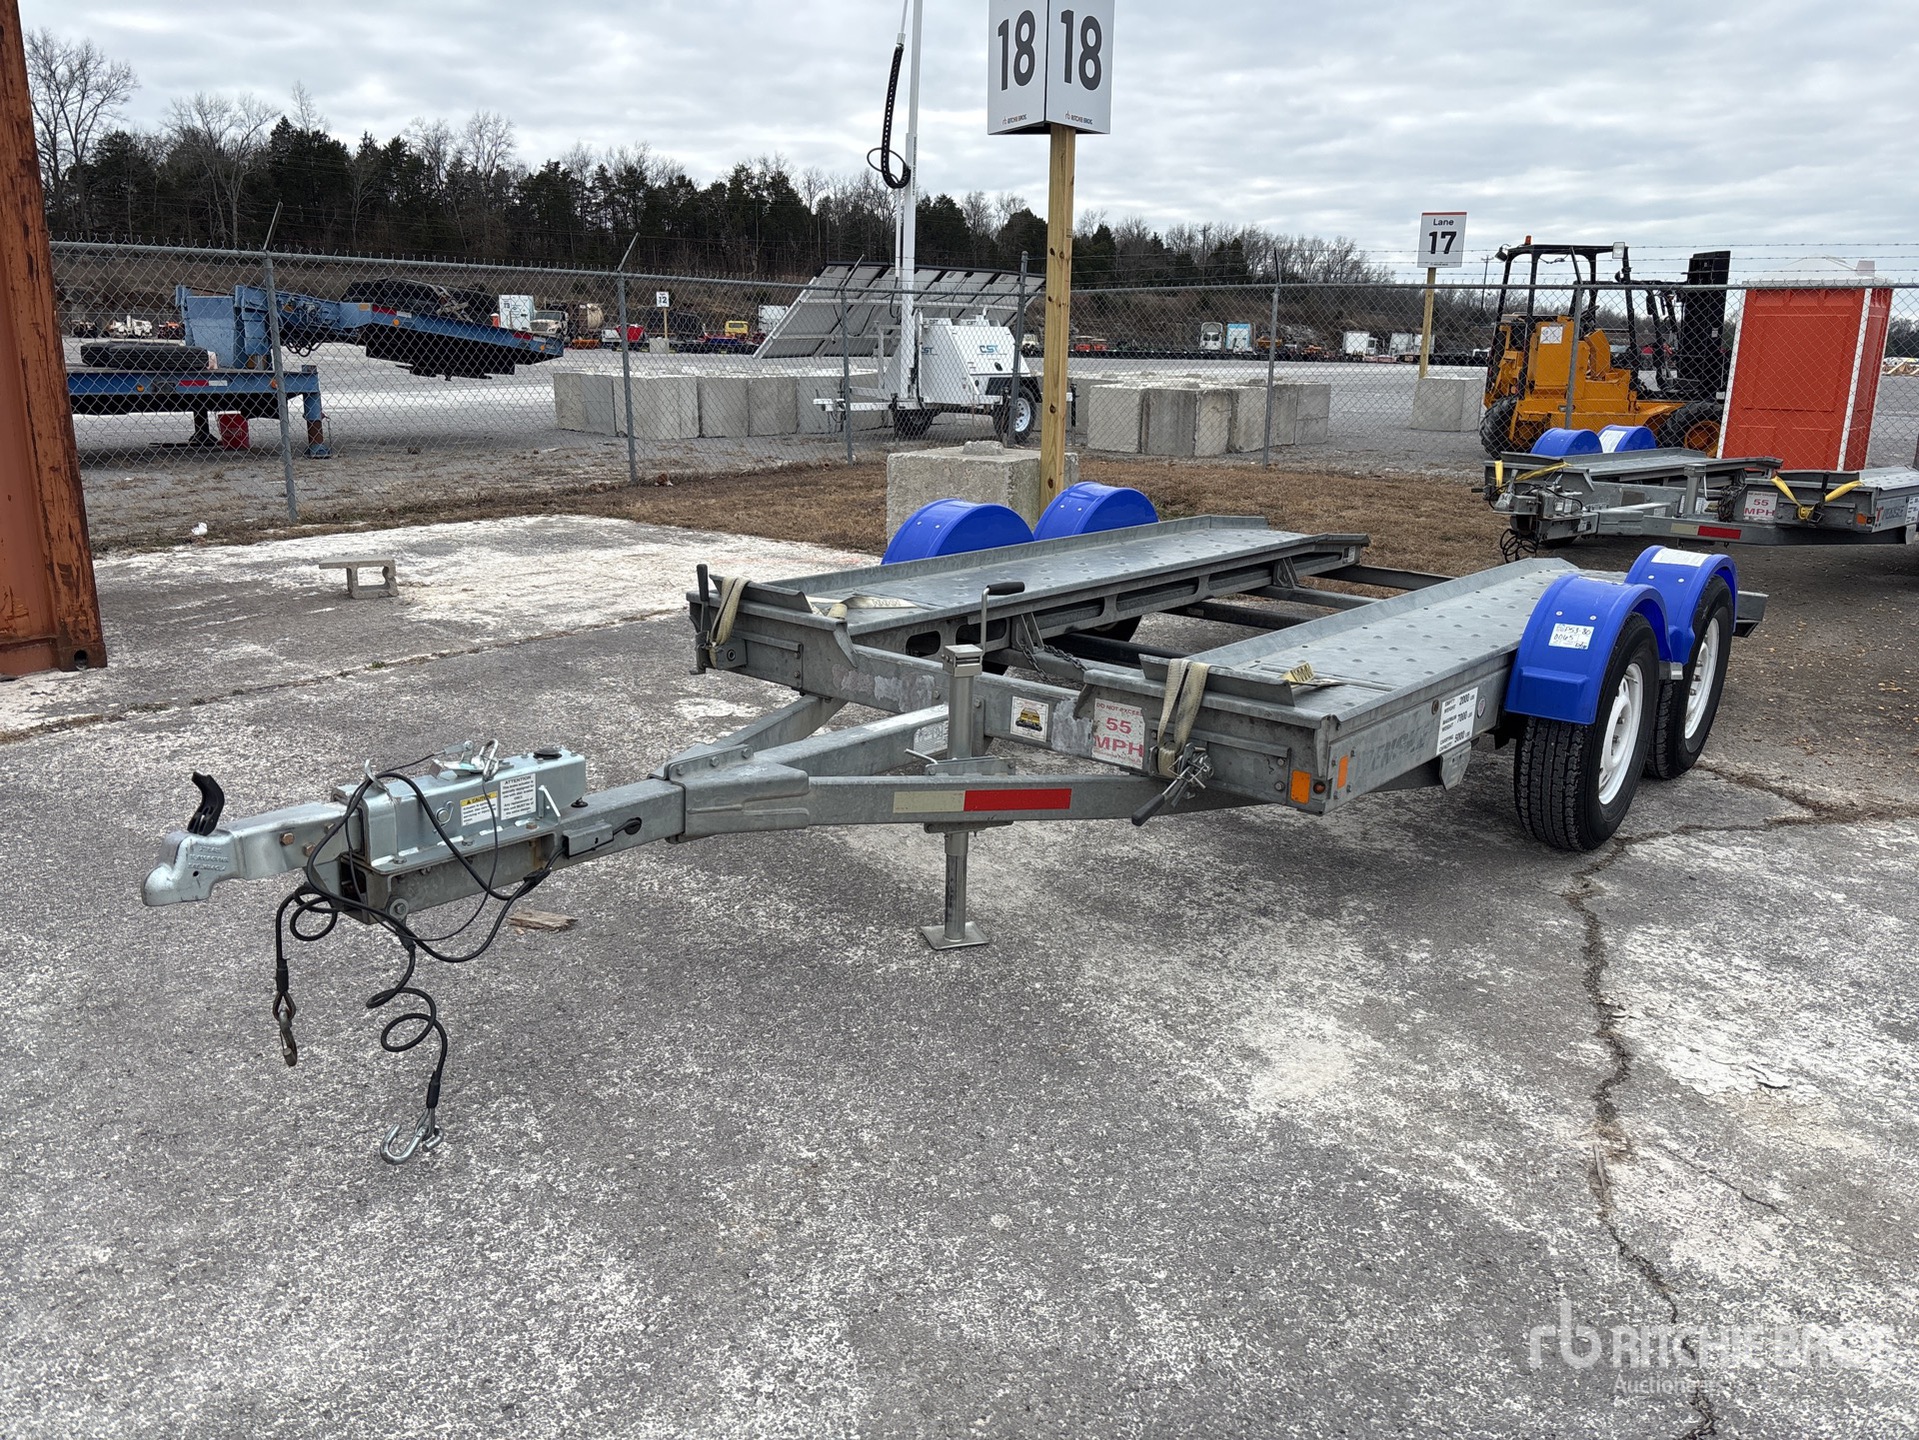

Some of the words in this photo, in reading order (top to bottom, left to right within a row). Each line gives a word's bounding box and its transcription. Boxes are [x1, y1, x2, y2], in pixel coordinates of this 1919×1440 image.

[998, 10, 1036, 91] 18
[1061, 9, 1102, 91] 18
[1433, 218, 1454, 226] Lane
[1428, 231, 1457, 254] 17
[658, 296, 667, 304] 12
[979, 345, 998, 354] CST
[1753, 498, 1769, 507] 55
[1744, 507, 1776, 516] MPH
[1105, 717, 1132, 734] 55
[1093, 735, 1144, 758] MPH
[504, 775, 531, 784] ATTENTION
